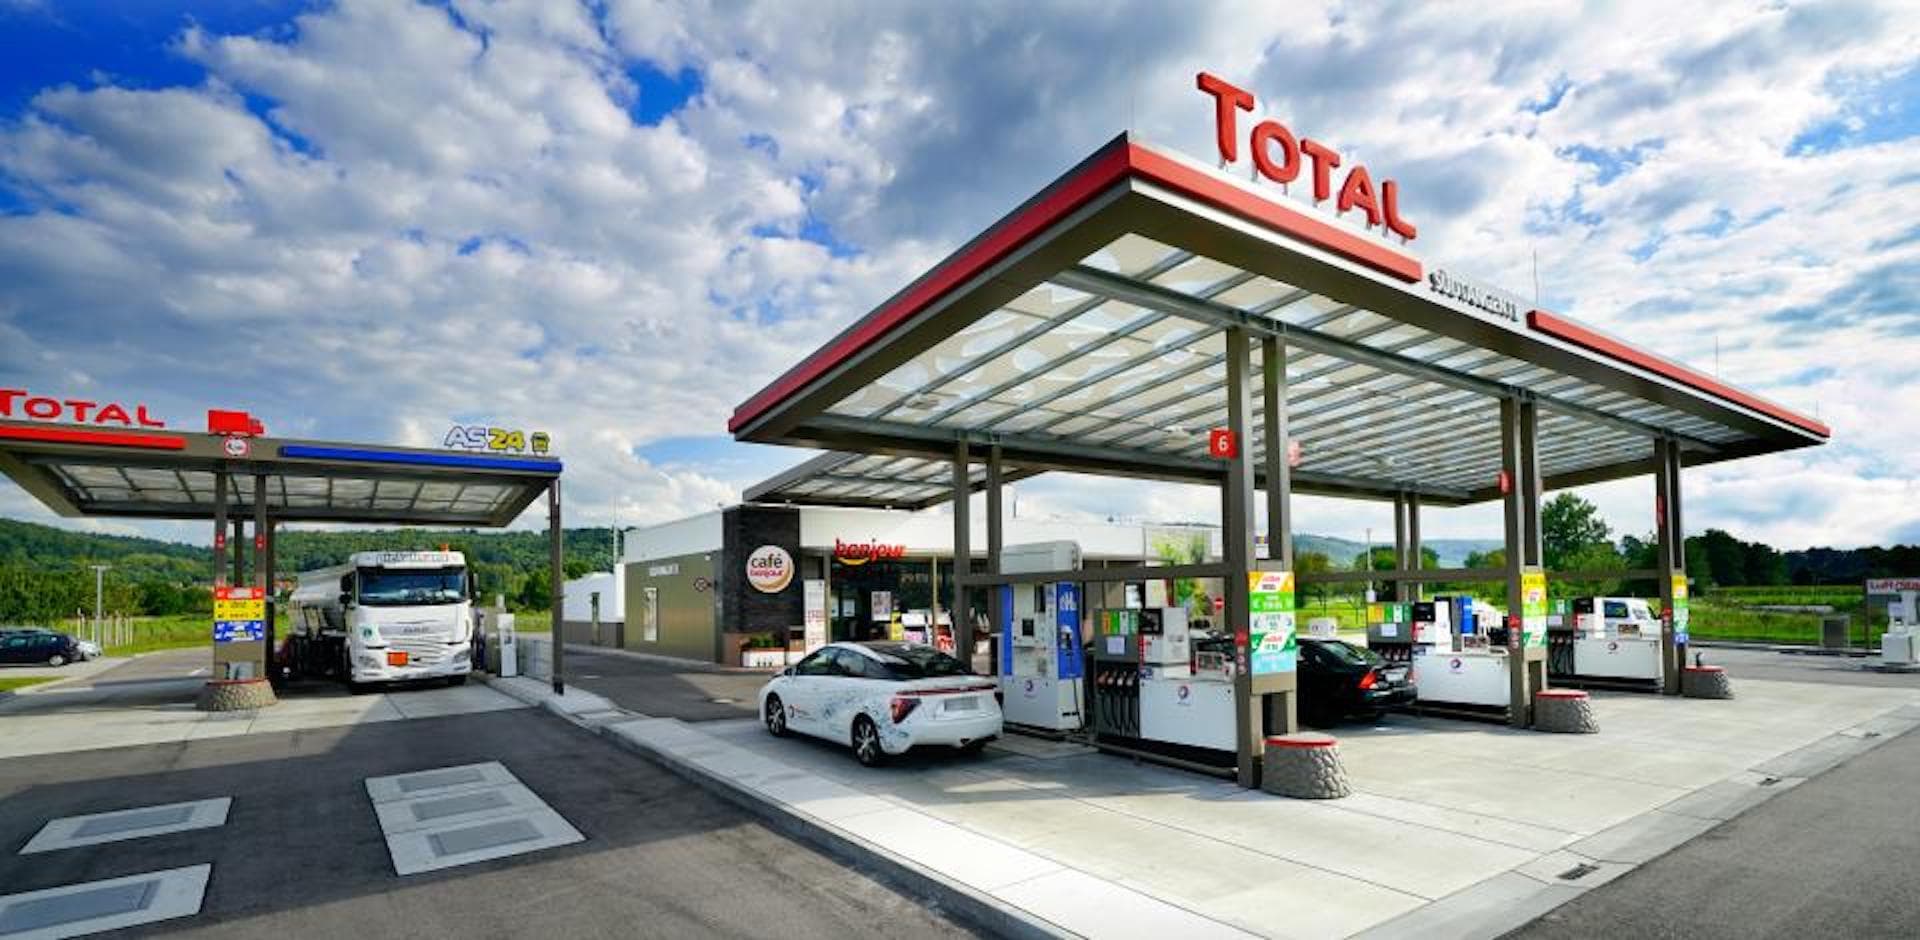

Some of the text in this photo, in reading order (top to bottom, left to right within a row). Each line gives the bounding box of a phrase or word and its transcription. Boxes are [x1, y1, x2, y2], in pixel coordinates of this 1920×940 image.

[1196, 72, 1417, 240] TOTAL
[0, 389, 165, 428] TOTAL
[1218, 434, 1229, 452] 6
[751, 553, 783, 568] café
[834, 537, 905, 562] bonjour
